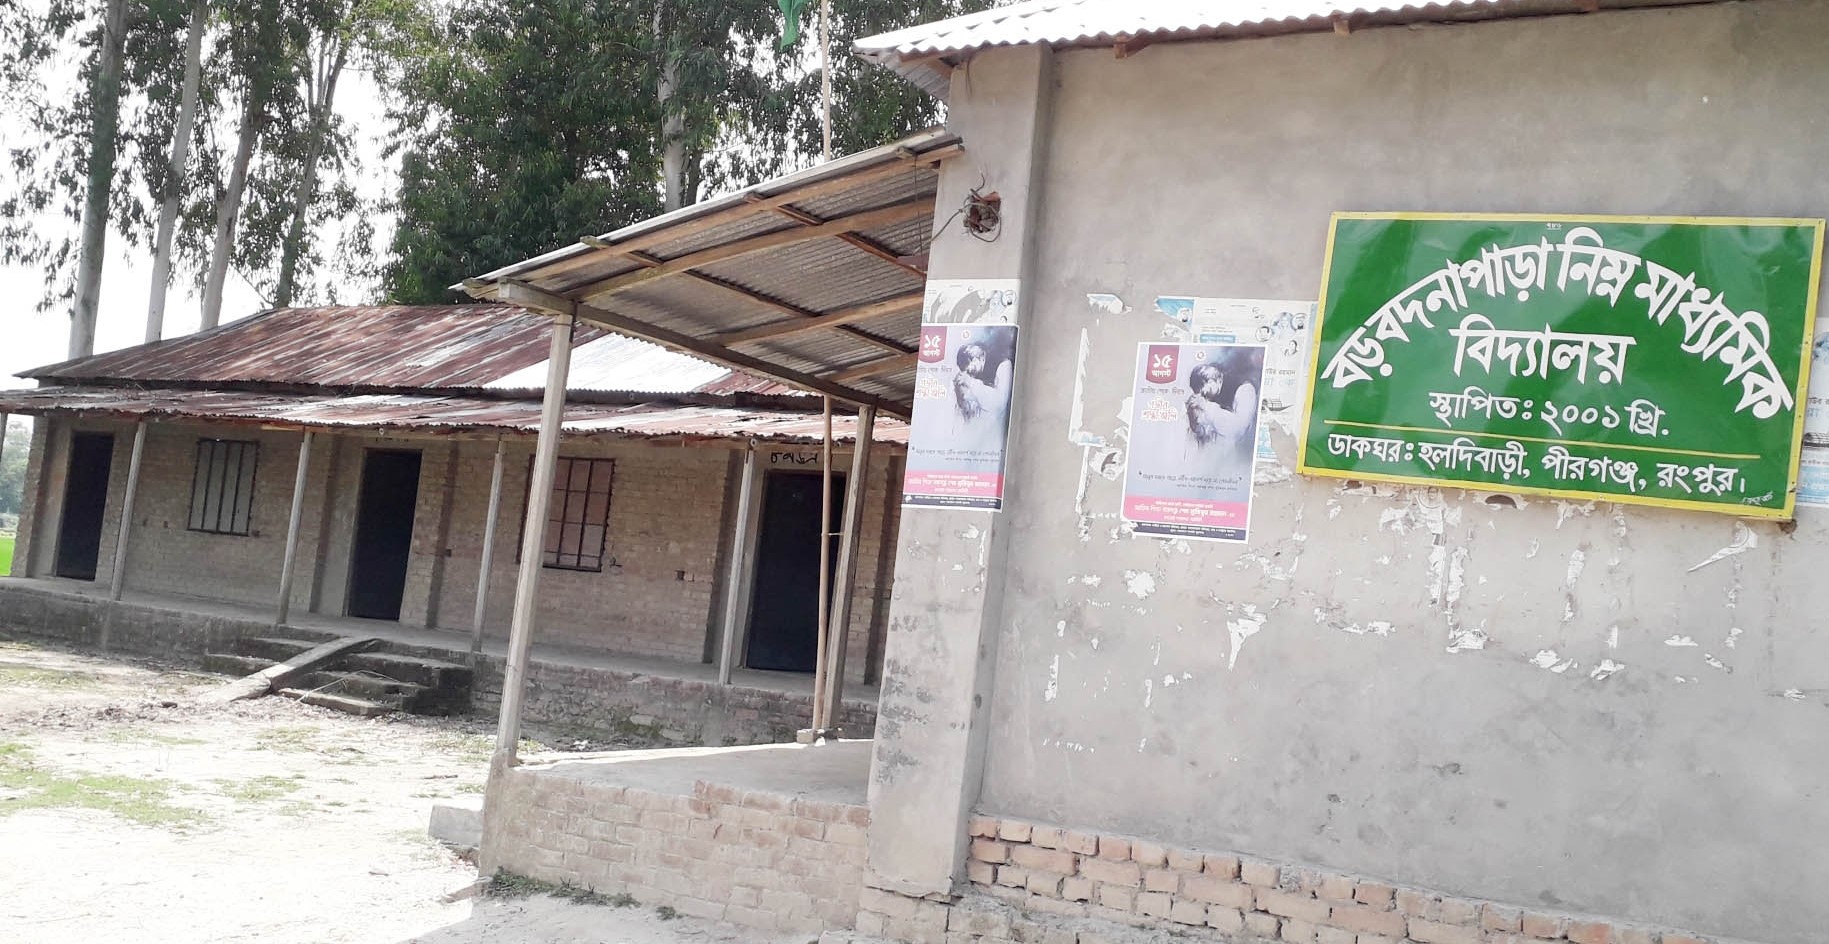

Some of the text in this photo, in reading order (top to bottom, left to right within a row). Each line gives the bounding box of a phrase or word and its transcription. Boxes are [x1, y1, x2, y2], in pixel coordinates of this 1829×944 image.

[1555, 226, 1642, 308] নিম্ন
[1634, 260, 1794, 420] মাধ্যমিক
[924, 335, 942, 349] ১৫
[1153, 353, 1174, 368] ১৫
[1447, 313, 1638, 386] বিদ্যালয়
[1541, 400, 1621, 437] ২০০১
